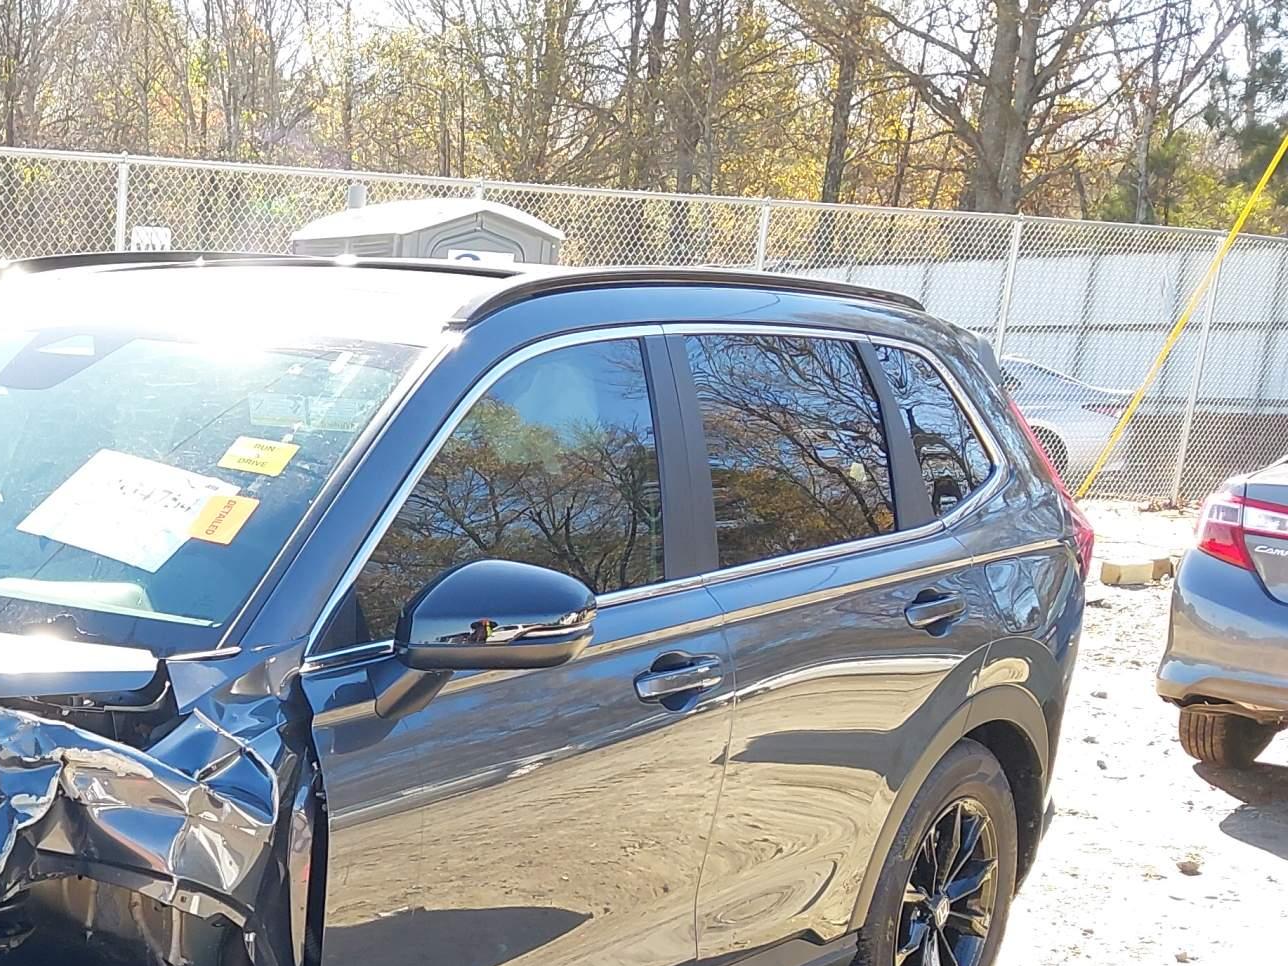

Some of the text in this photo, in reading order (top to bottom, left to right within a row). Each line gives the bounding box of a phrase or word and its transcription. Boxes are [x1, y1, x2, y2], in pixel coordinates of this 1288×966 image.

[253, 443, 277, 452] RUN
[237, 457, 269, 467] DRIVE
[204, 498, 237, 536] DETAILED
[1254, 545, 1288, 557] Cam
